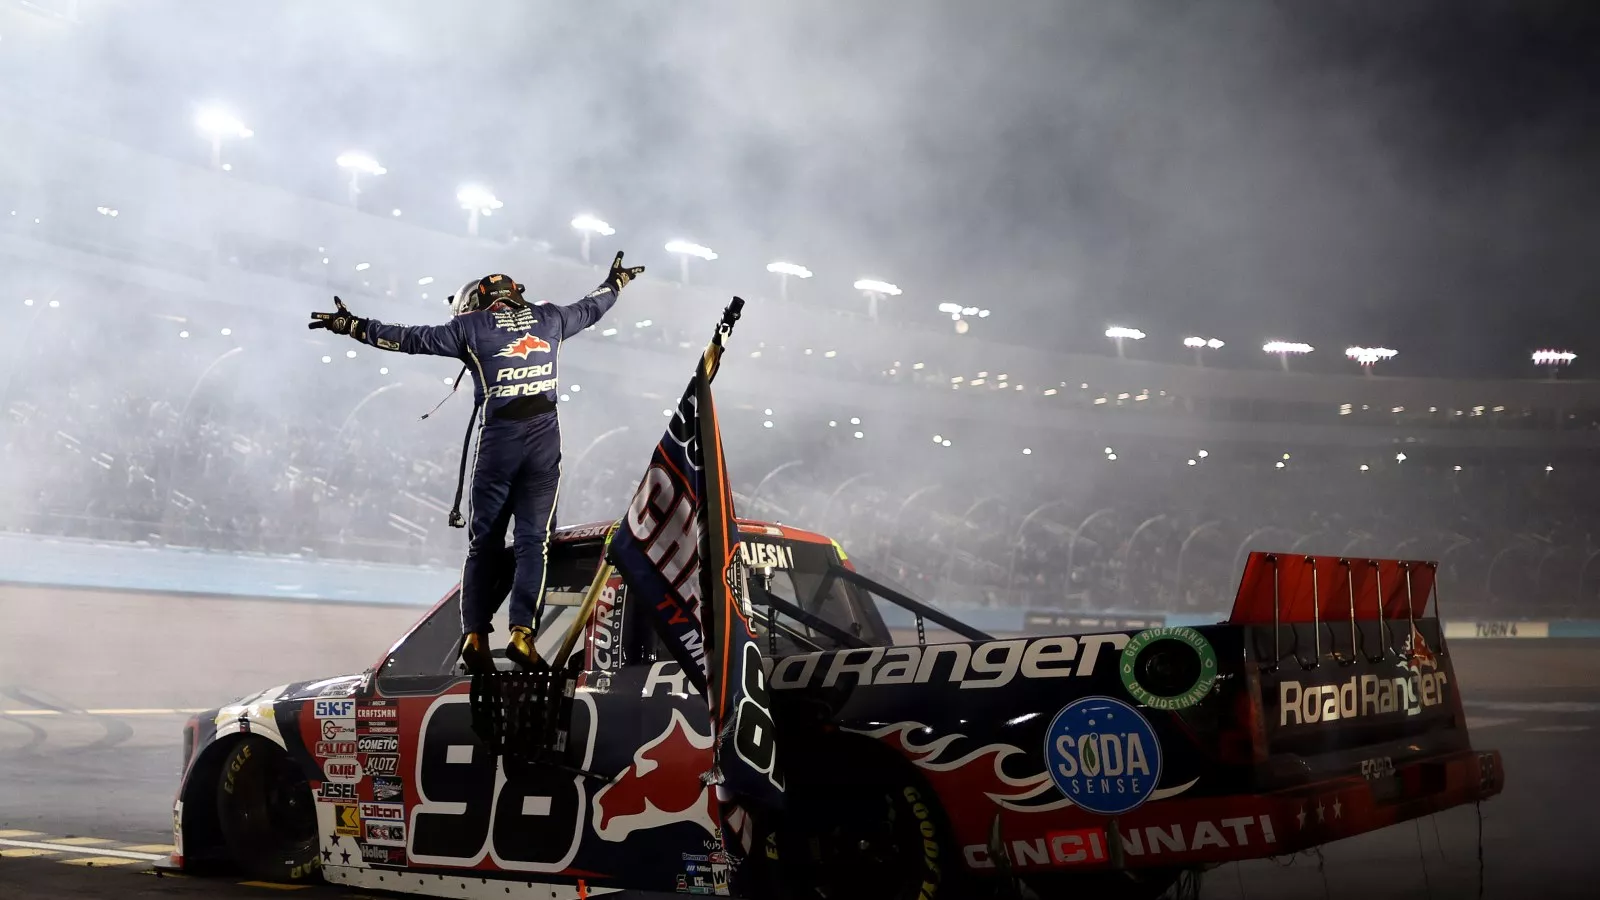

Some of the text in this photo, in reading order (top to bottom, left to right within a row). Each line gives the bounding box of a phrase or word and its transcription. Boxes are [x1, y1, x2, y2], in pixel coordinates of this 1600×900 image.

[496, 362, 553, 382] Road
[488, 377, 558, 398] Ranger
[739, 541, 795, 569] AJESKI
[656, 593, 689, 625] TY
[594, 584, 615, 670] CURB
[612, 583, 624, 668] RECORDS
[1475, 622, 1518, 637] TURN 4
[1124, 627, 1209, 657] GET BIOETHANOL
[640, 633, 1130, 698] Rd Ranger
[1128, 678, 1214, 710] GET BIOETHANOL
[1280, 671, 1448, 727] Road Ranger
[315, 701, 355, 716] SKF
[357, 709, 397, 718] CRAFTSMAN
[316, 742, 357, 755] CALICO
[358, 737, 398, 751] COMETIC
[367, 757, 397, 771] KLOTZ
[1055, 731, 1151, 778] SODA
[224, 743, 253, 795] EAGLE
[317, 783, 358, 799] JESEL
[407, 693, 600, 873] 98
[1071, 778, 1141, 795] SENSE
[361, 805, 401, 819] tilton
[367, 824, 404, 841] KOOKS
[903, 785, 943, 900] GOODYE
[362, 845, 389, 863] Holley
[703, 839, 722, 850] Kub
